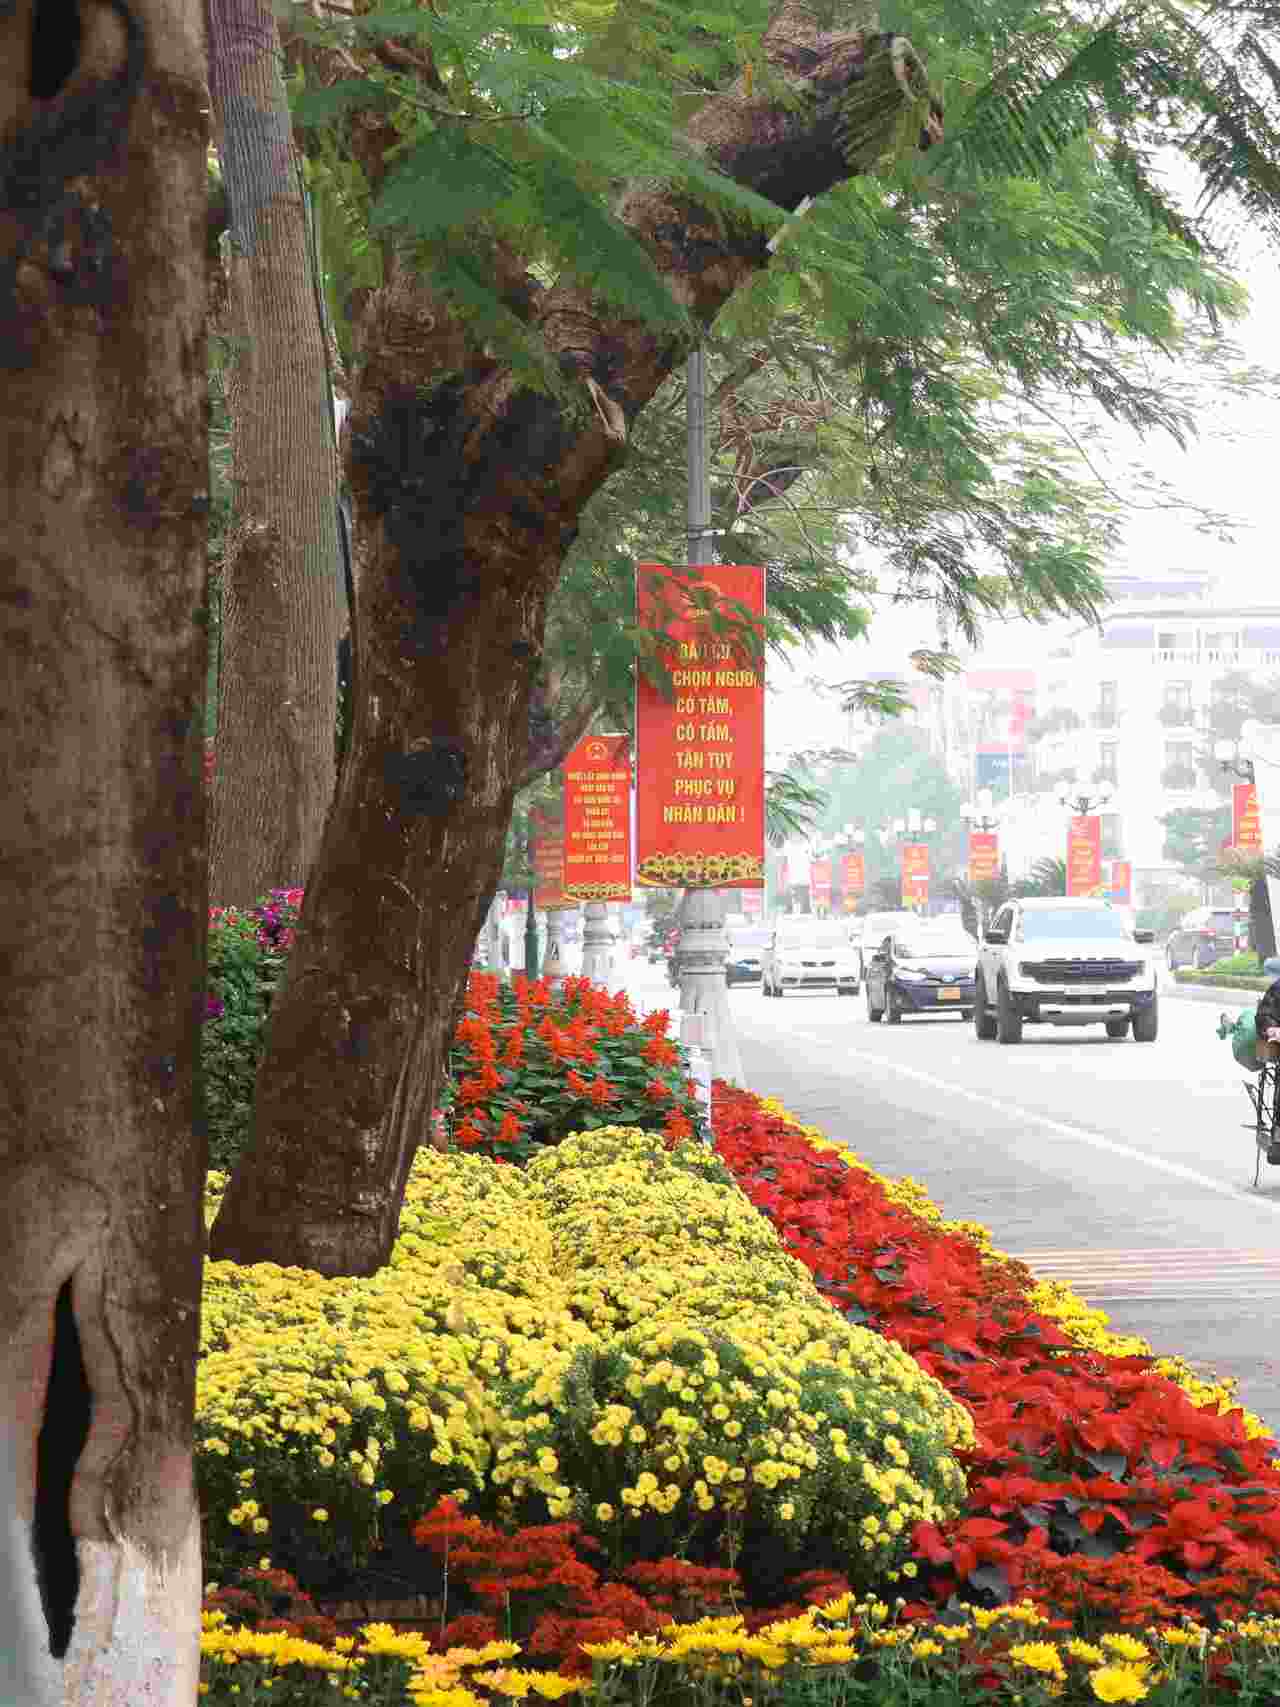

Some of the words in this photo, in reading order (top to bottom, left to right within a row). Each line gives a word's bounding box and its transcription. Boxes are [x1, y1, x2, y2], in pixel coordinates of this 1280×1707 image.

[673, 669, 711, 691] CHỌN
[676, 692, 695, 713] CÓ
[676, 720, 695, 742] CÓ
[676, 746, 704, 772] TẬN
[708, 751, 733, 771] TỤY
[675, 779, 713, 799] PHỤC
[717, 779, 735, 799] VỤ
[663, 802, 702, 823] NHÂN
[706, 802, 737, 823] DÂN
